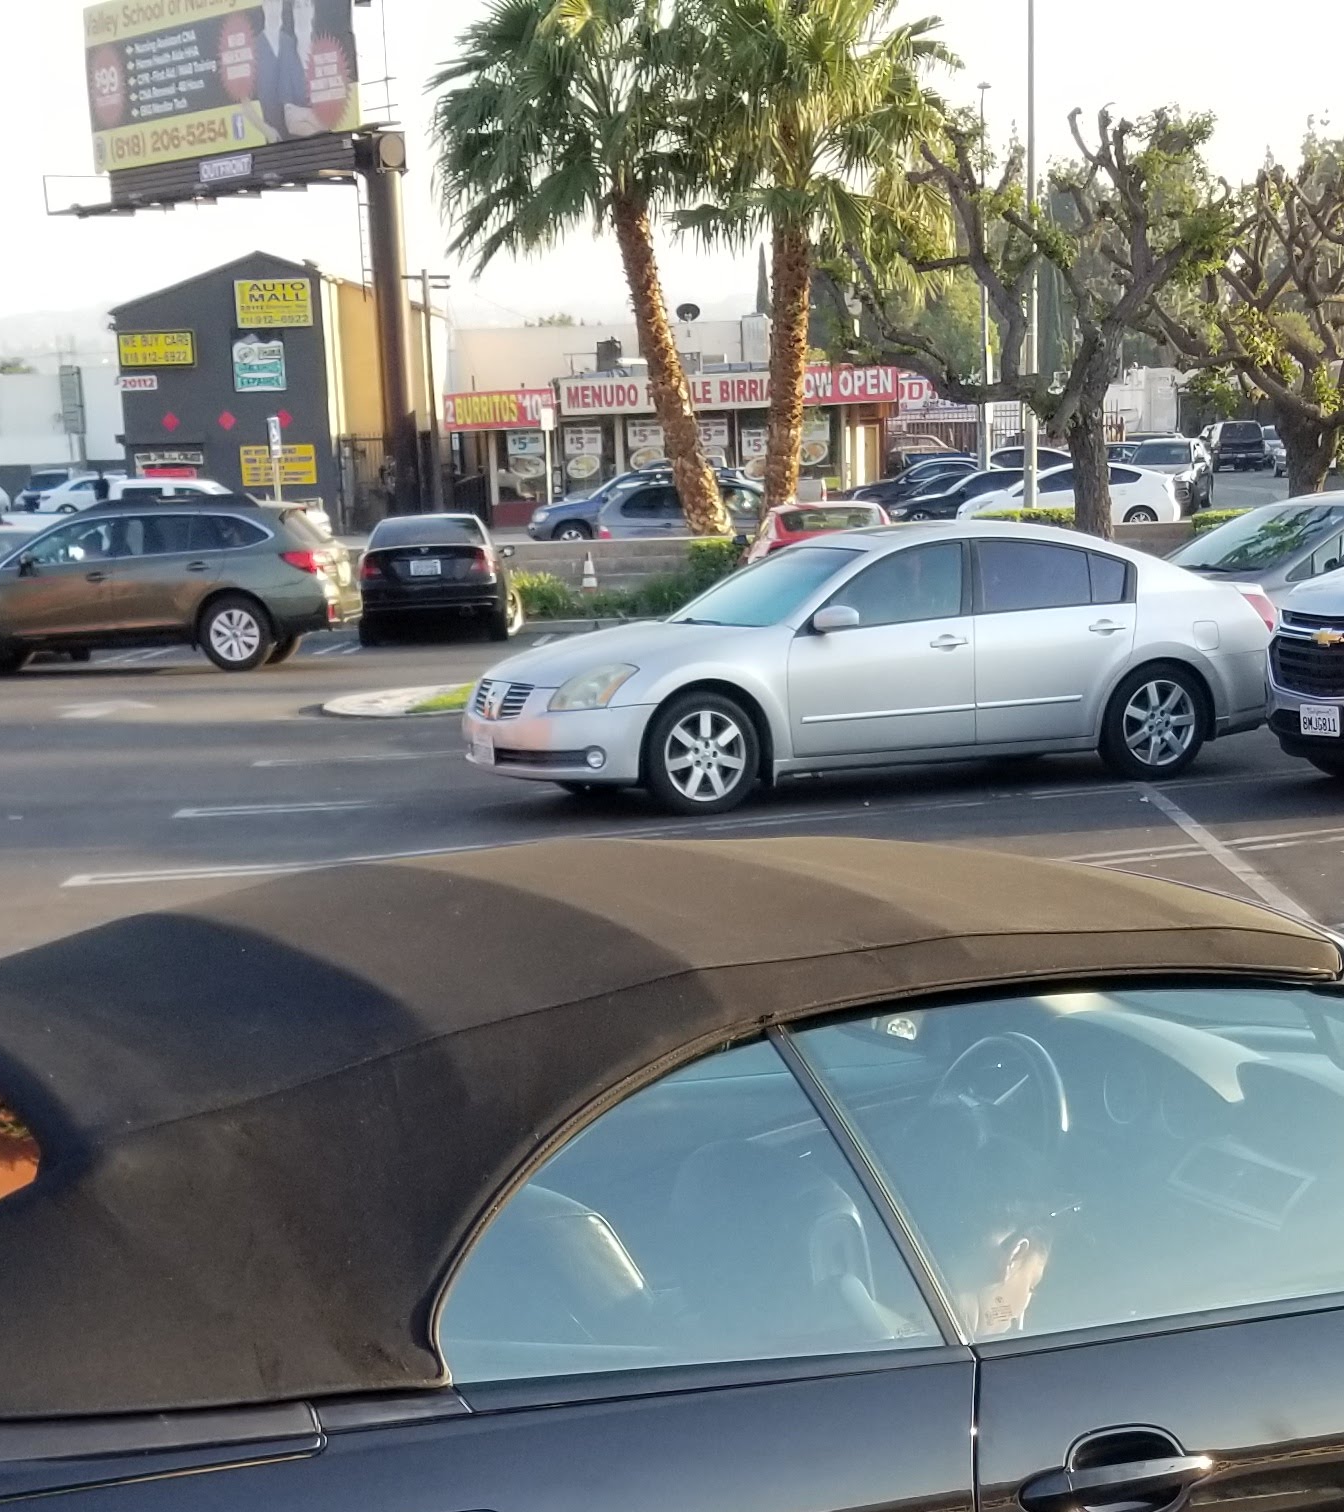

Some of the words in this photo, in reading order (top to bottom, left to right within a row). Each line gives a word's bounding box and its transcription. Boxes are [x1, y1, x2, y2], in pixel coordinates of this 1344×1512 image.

[122, 0, 165, 27] School
[168, 0, 182, 16] of
[95, 66, 117, 93] $99
[110, 130, 146, 162] (818)
[150, 118, 227, 152] 206-5254
[201, 158, 250, 179] OUTFRONT
[249, 282, 305, 292] AUTO
[249, 292, 308, 303] MALL
[123, 336, 136, 347] WE
[141, 335, 158, 346] BUY
[165, 334, 188, 346] CARS
[122, 378, 155, 388] 20112
[803, 371, 833, 399] OW
[839, 368, 893, 397] OPEN
[566, 384, 638, 409] MENUDO
[445, 400, 455, 423] 2
[454, 394, 518, 425] BURRITOS
[1302, 716, 1337, 732] 8MJG811
